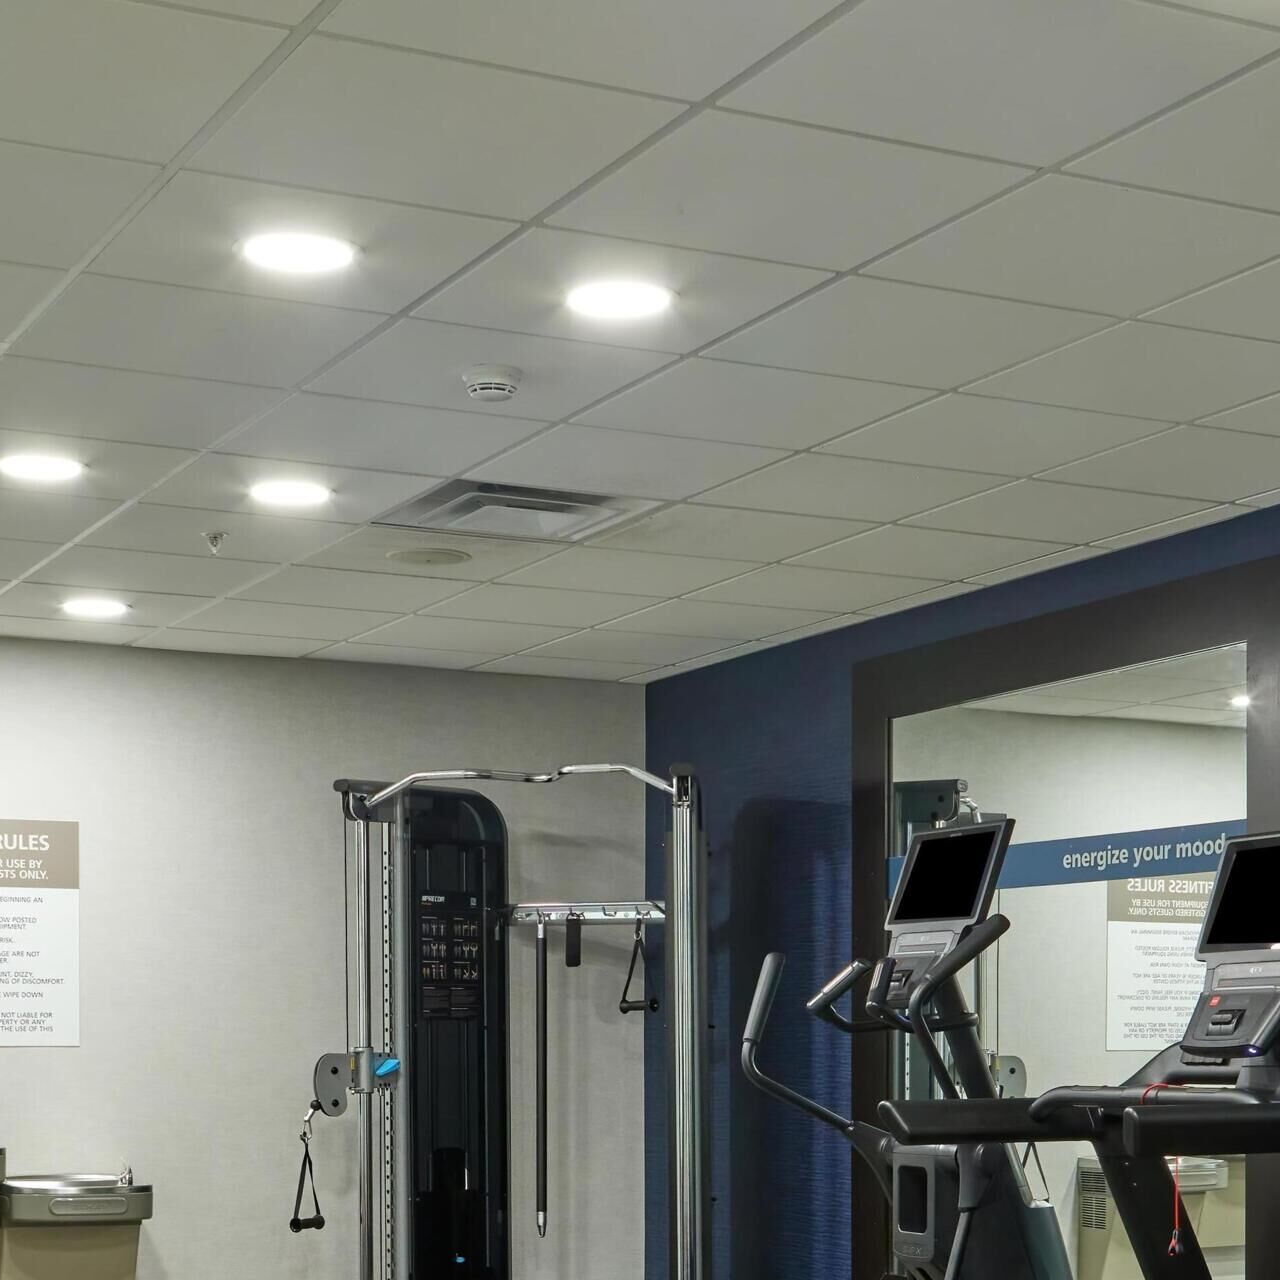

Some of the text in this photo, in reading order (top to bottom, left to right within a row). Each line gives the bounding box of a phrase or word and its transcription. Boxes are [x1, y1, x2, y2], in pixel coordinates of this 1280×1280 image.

[7, 858, 26, 868] USE
[29, 859, 42, 869] BY
[1063, 832, 1226, 871] energize your mood
